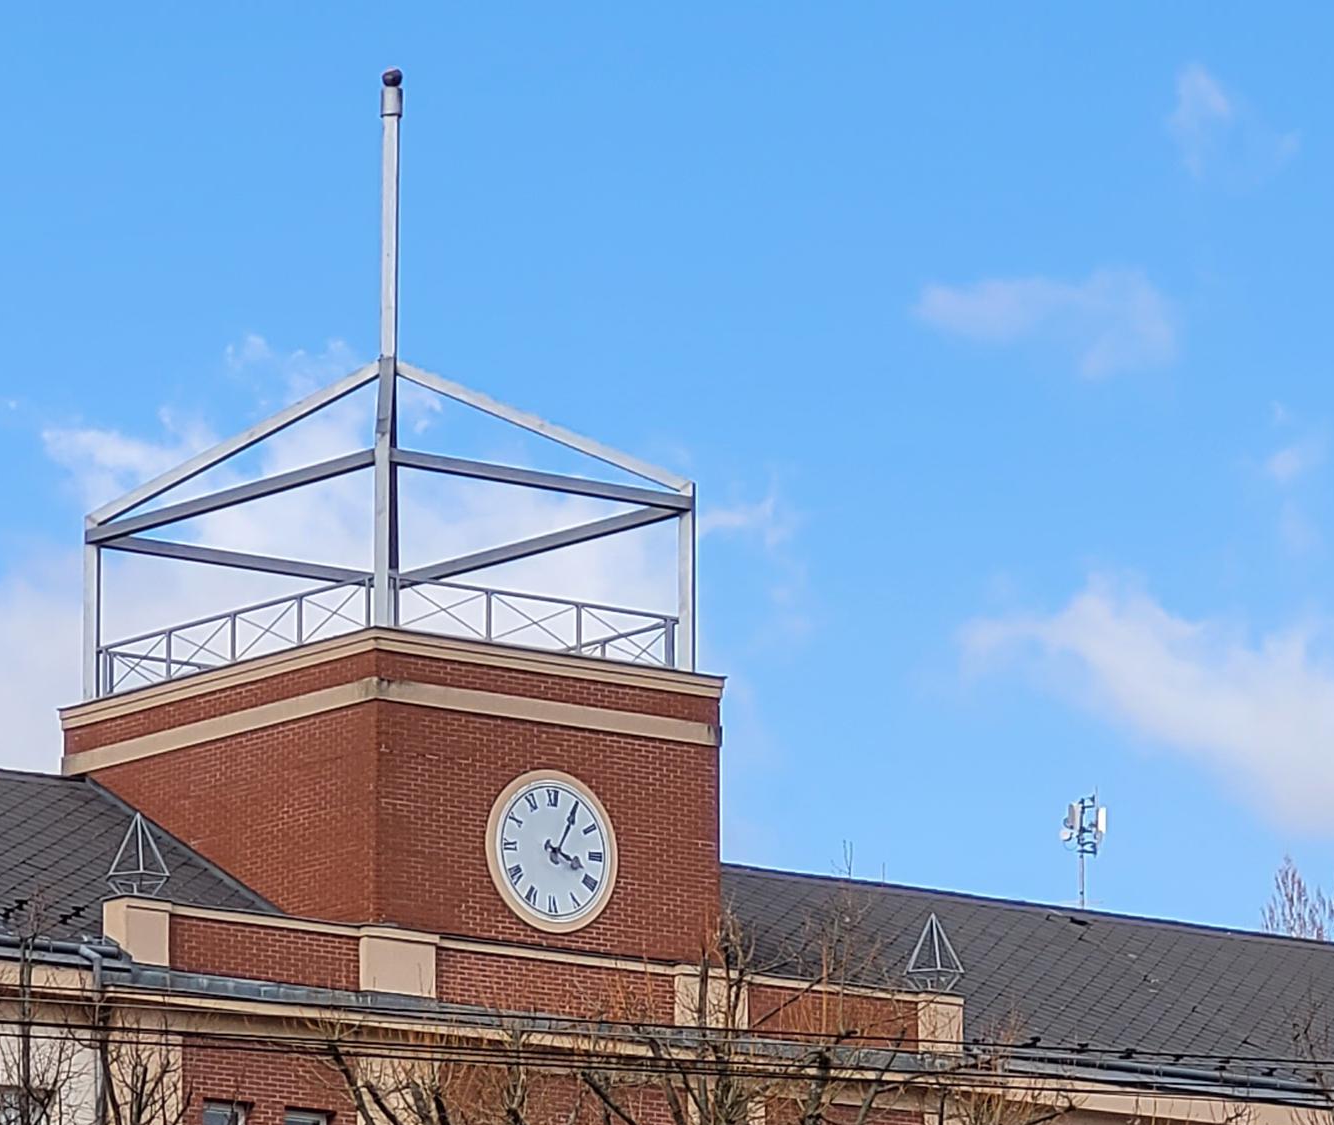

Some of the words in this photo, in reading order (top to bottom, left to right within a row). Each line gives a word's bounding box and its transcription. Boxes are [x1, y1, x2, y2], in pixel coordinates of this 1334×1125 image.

[546, 789, 559, 807] XII
[509, 812, 523, 828] X
[582, 823, 597, 835] II
[503, 838, 517, 851] IX
[588, 851, 602, 862] III
[508, 864, 524, 886] VIII
[524, 885, 538, 906] VII
[548, 895, 558, 913] VI
[569, 892, 581, 909] V
